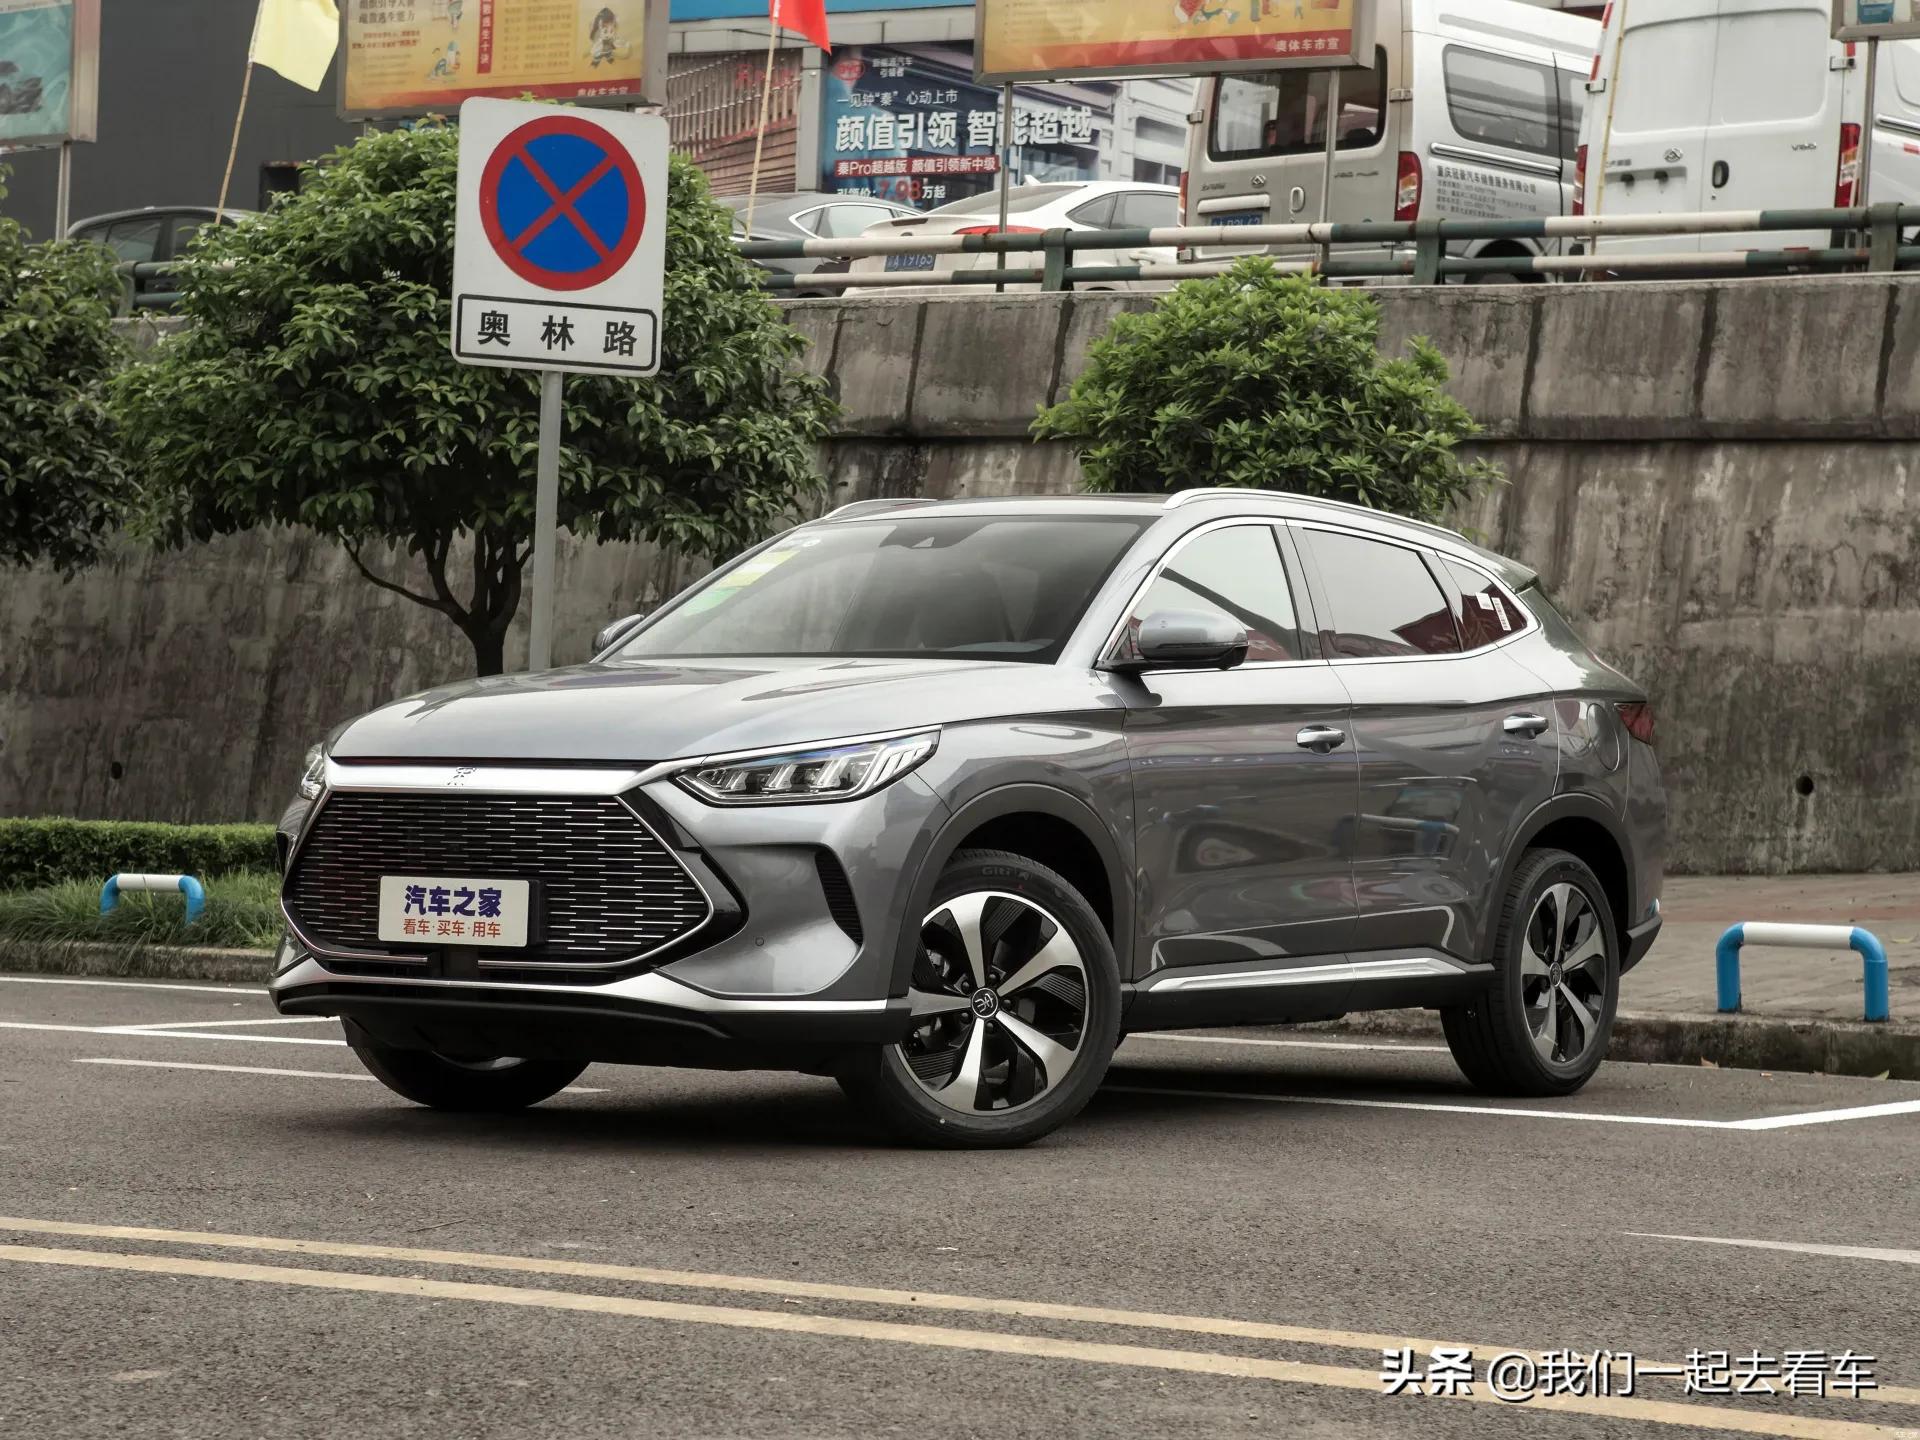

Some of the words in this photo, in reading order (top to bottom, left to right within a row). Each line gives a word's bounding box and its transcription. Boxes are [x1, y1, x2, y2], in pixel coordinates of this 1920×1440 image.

[906, 89, 959, 105] 心动上市
[835, 111, 958, 152] 颜值引领
[477, 310, 638, 357] 奥林路
[404, 884, 502, 918] 汽车之家
